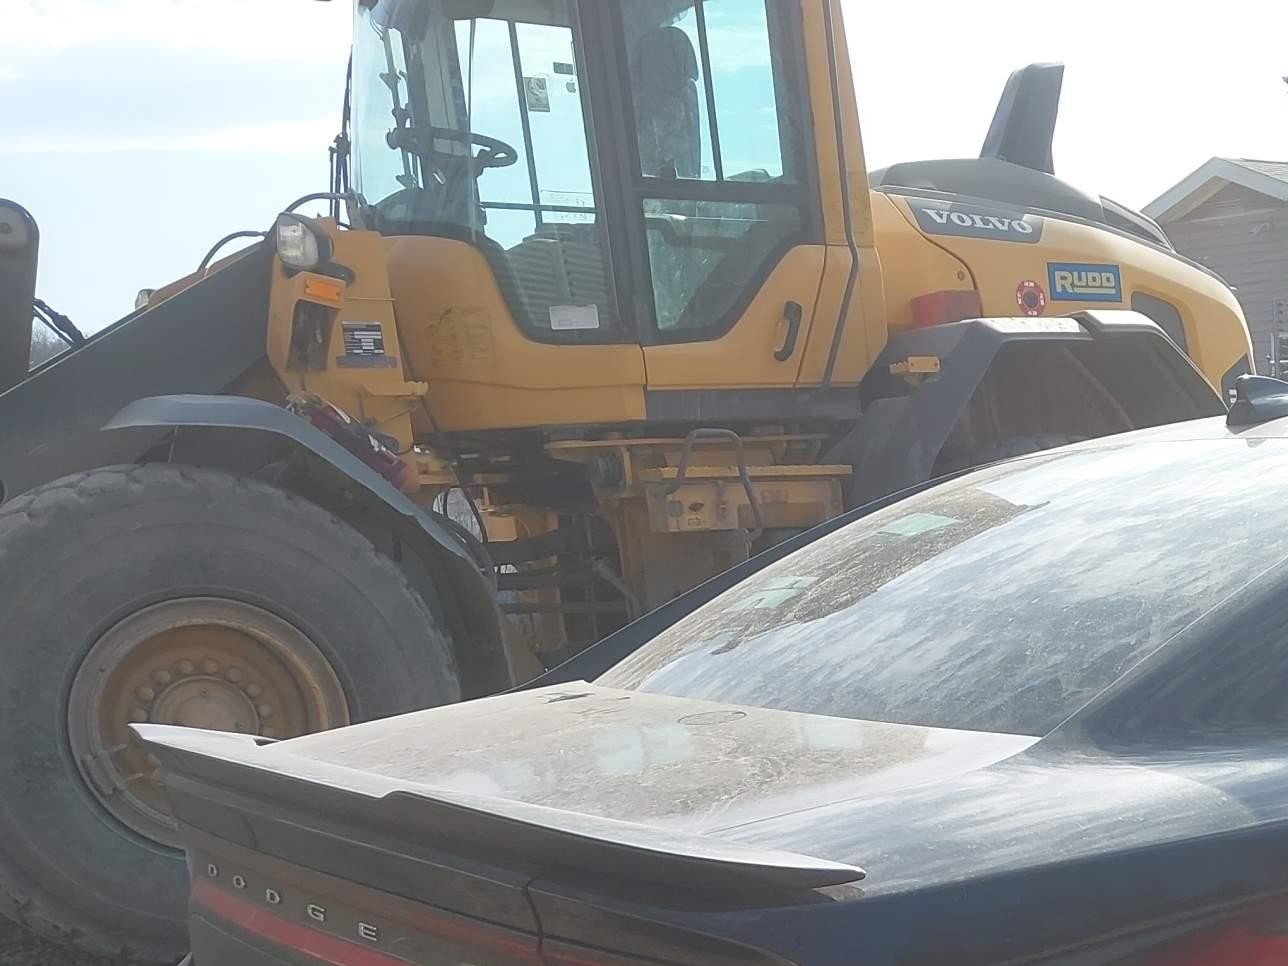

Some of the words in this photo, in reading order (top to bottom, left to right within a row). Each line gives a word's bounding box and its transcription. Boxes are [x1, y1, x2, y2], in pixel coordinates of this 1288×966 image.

[921, 208, 1033, 234] VOLVO
[1054, 270, 1116, 294] RUDD
[207, 863, 378, 942] DODGE
